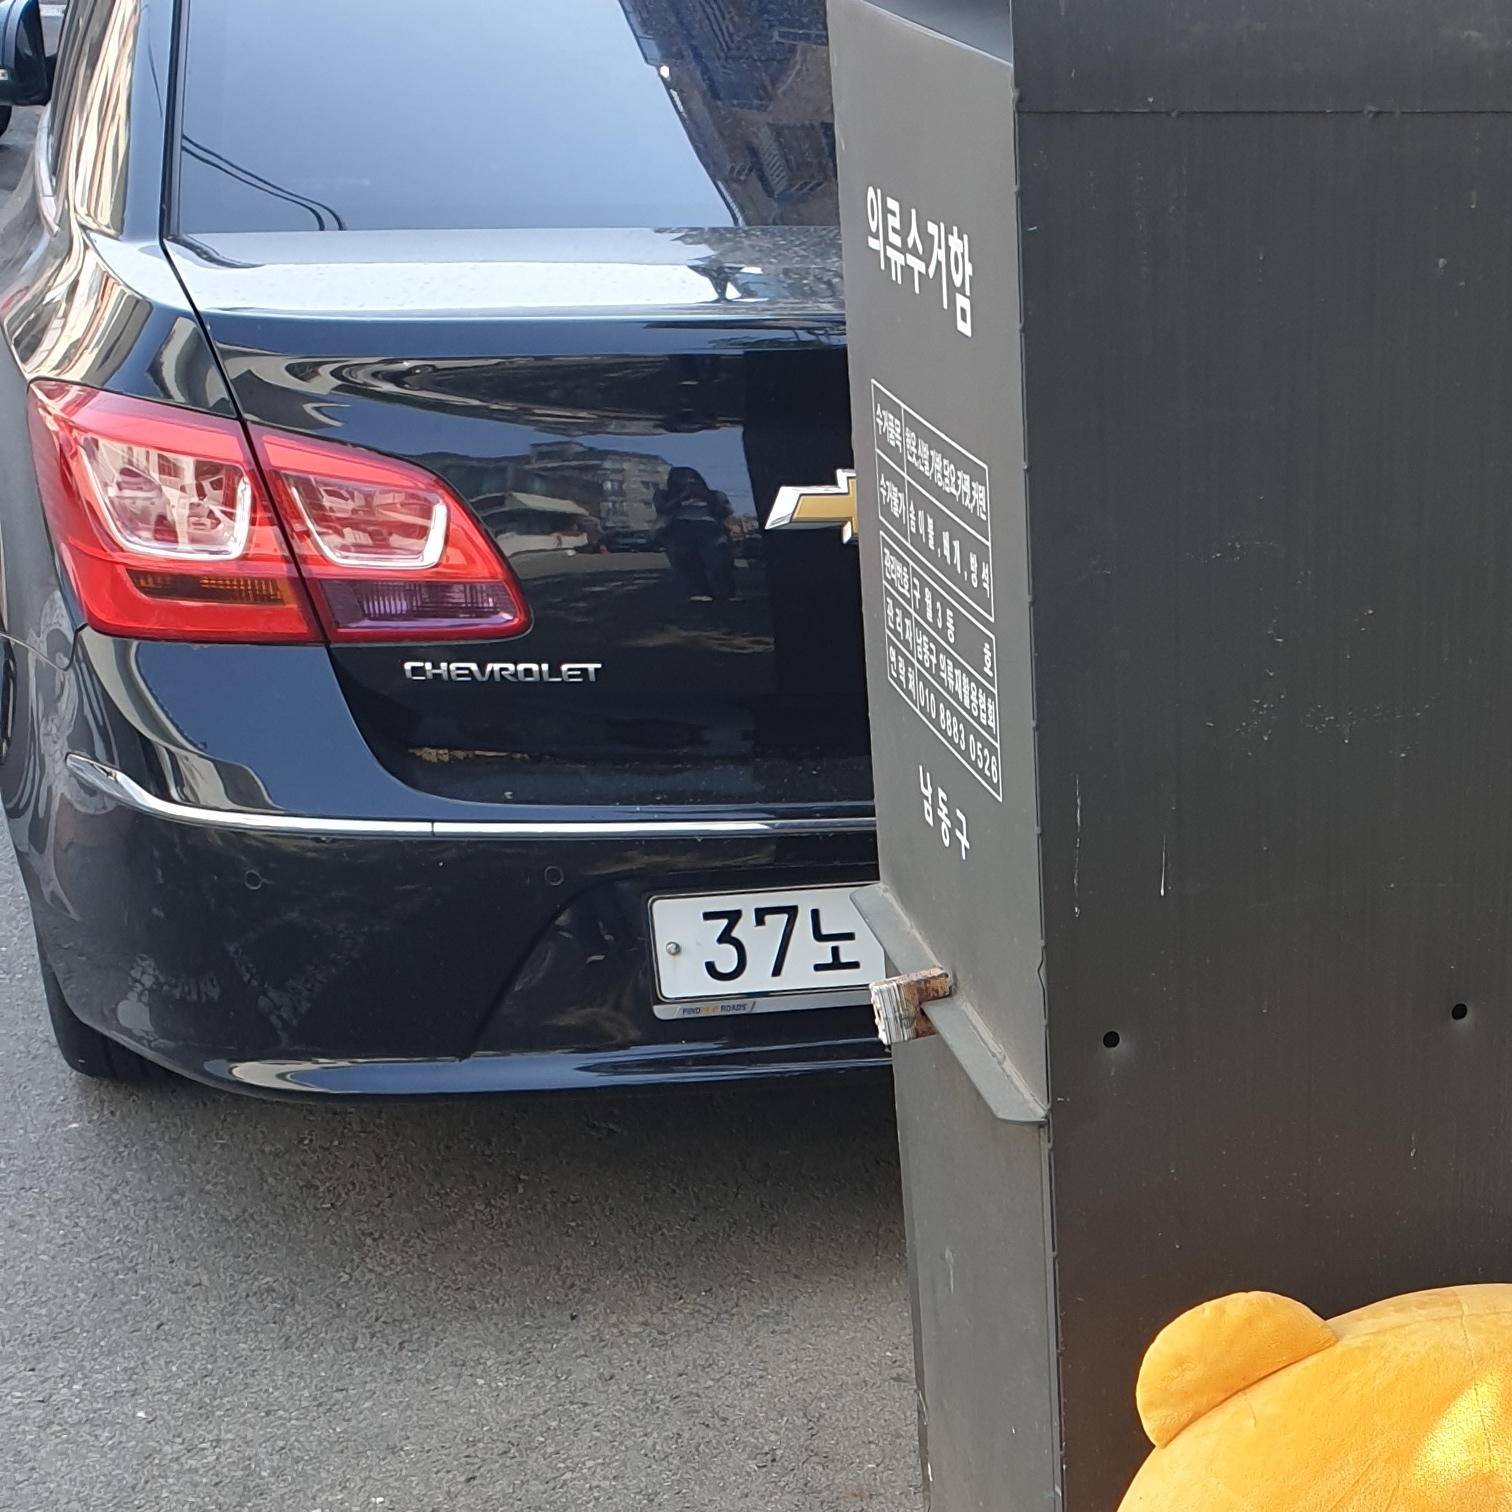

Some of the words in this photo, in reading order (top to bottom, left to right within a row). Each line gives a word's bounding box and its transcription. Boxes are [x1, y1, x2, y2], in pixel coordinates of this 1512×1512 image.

[866, 186, 972, 337] 의류수거함
[875, 402, 902, 453] 수거품목
[879, 473, 906, 525] 수거불가
[883, 547, 910, 598] 관리번호
[403, 661, 602, 682] CHEVROLET
[916, 627, 937, 676] 남동구
[918, 680, 936, 720] 010
[939, 703, 966, 751] 8883
[969, 733, 998, 785] 0526
[702, 905, 861, 982] 37노
